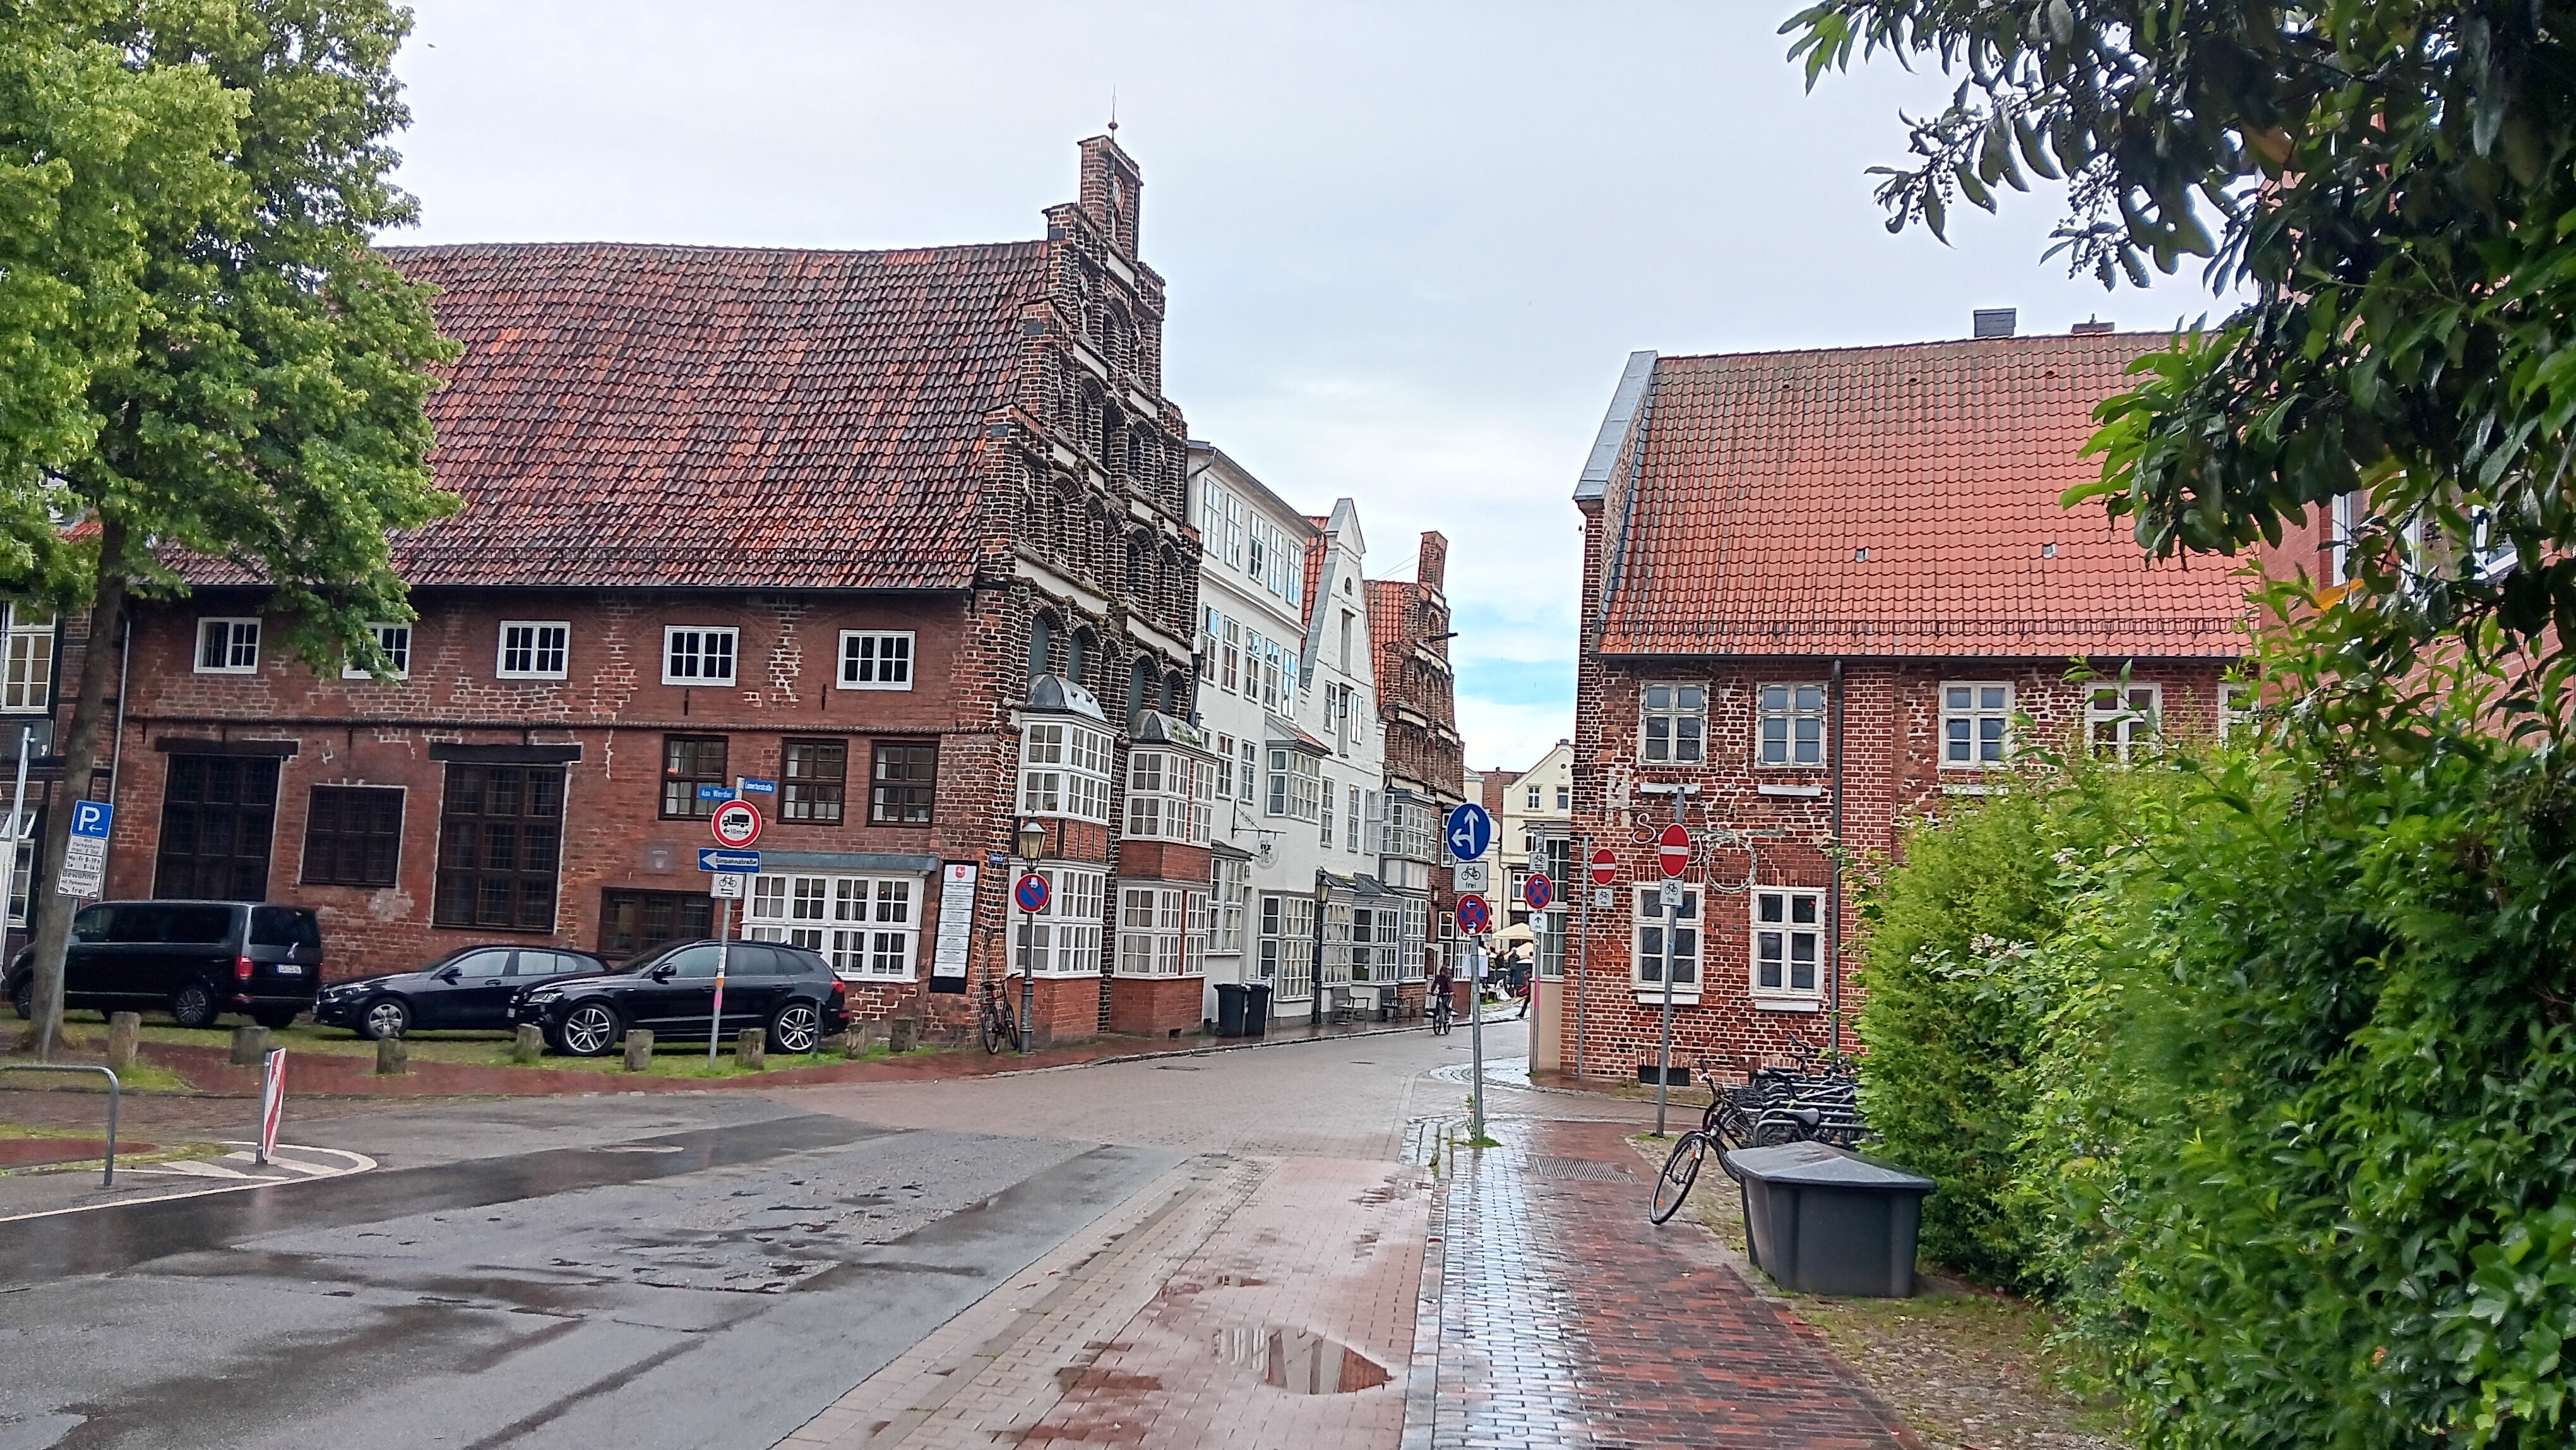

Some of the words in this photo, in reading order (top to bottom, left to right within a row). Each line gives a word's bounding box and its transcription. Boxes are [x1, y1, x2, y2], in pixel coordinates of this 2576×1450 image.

[78, 806, 100, 831] P
[62, 870, 99, 880] Bewohner
[72, 886, 85, 894] frei
